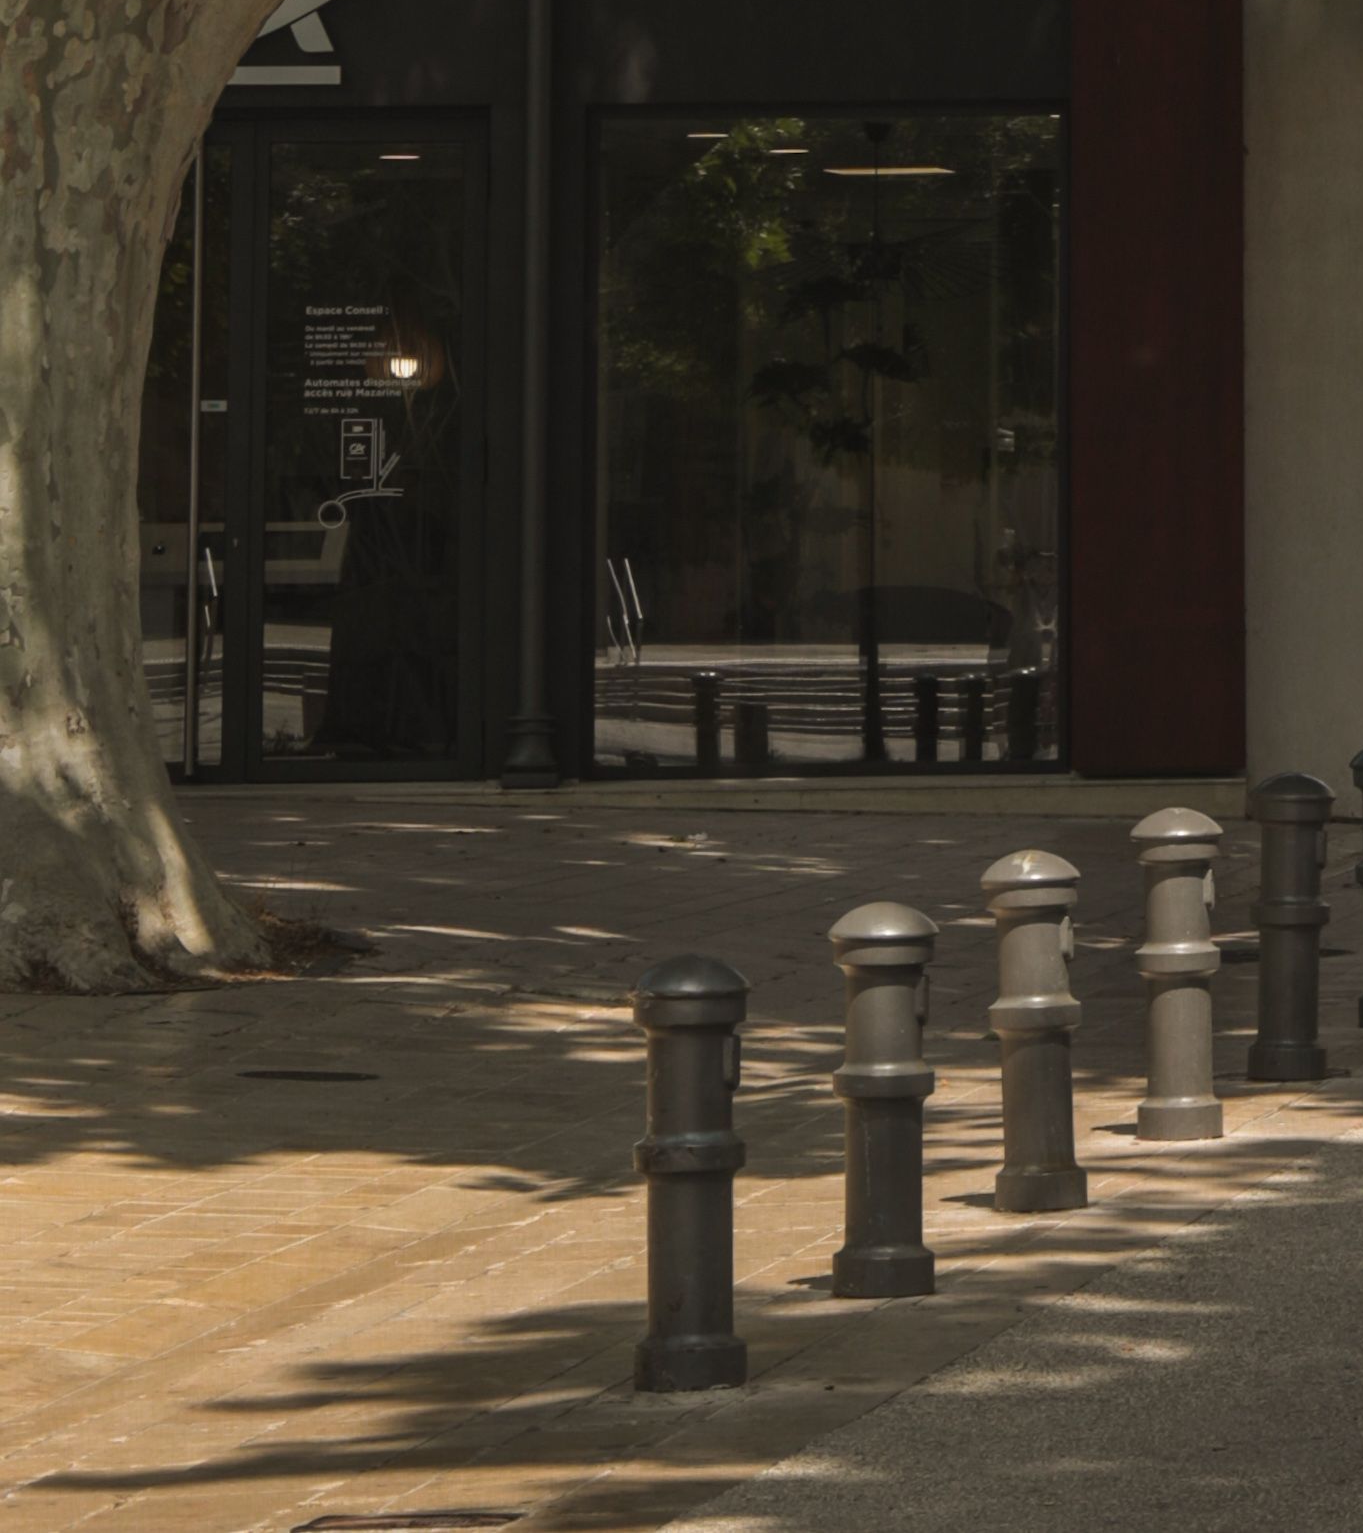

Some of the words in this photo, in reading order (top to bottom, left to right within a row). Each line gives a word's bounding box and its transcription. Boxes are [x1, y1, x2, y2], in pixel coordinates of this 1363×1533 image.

[306, 306, 342, 317] Espace
[345, 306, 383, 315] Conseil
[304, 378, 360, 388] Automates
[304, 388, 332, 397] accès
[336, 389, 352, 398] rue
[355, 388, 402, 397] Mazarine
